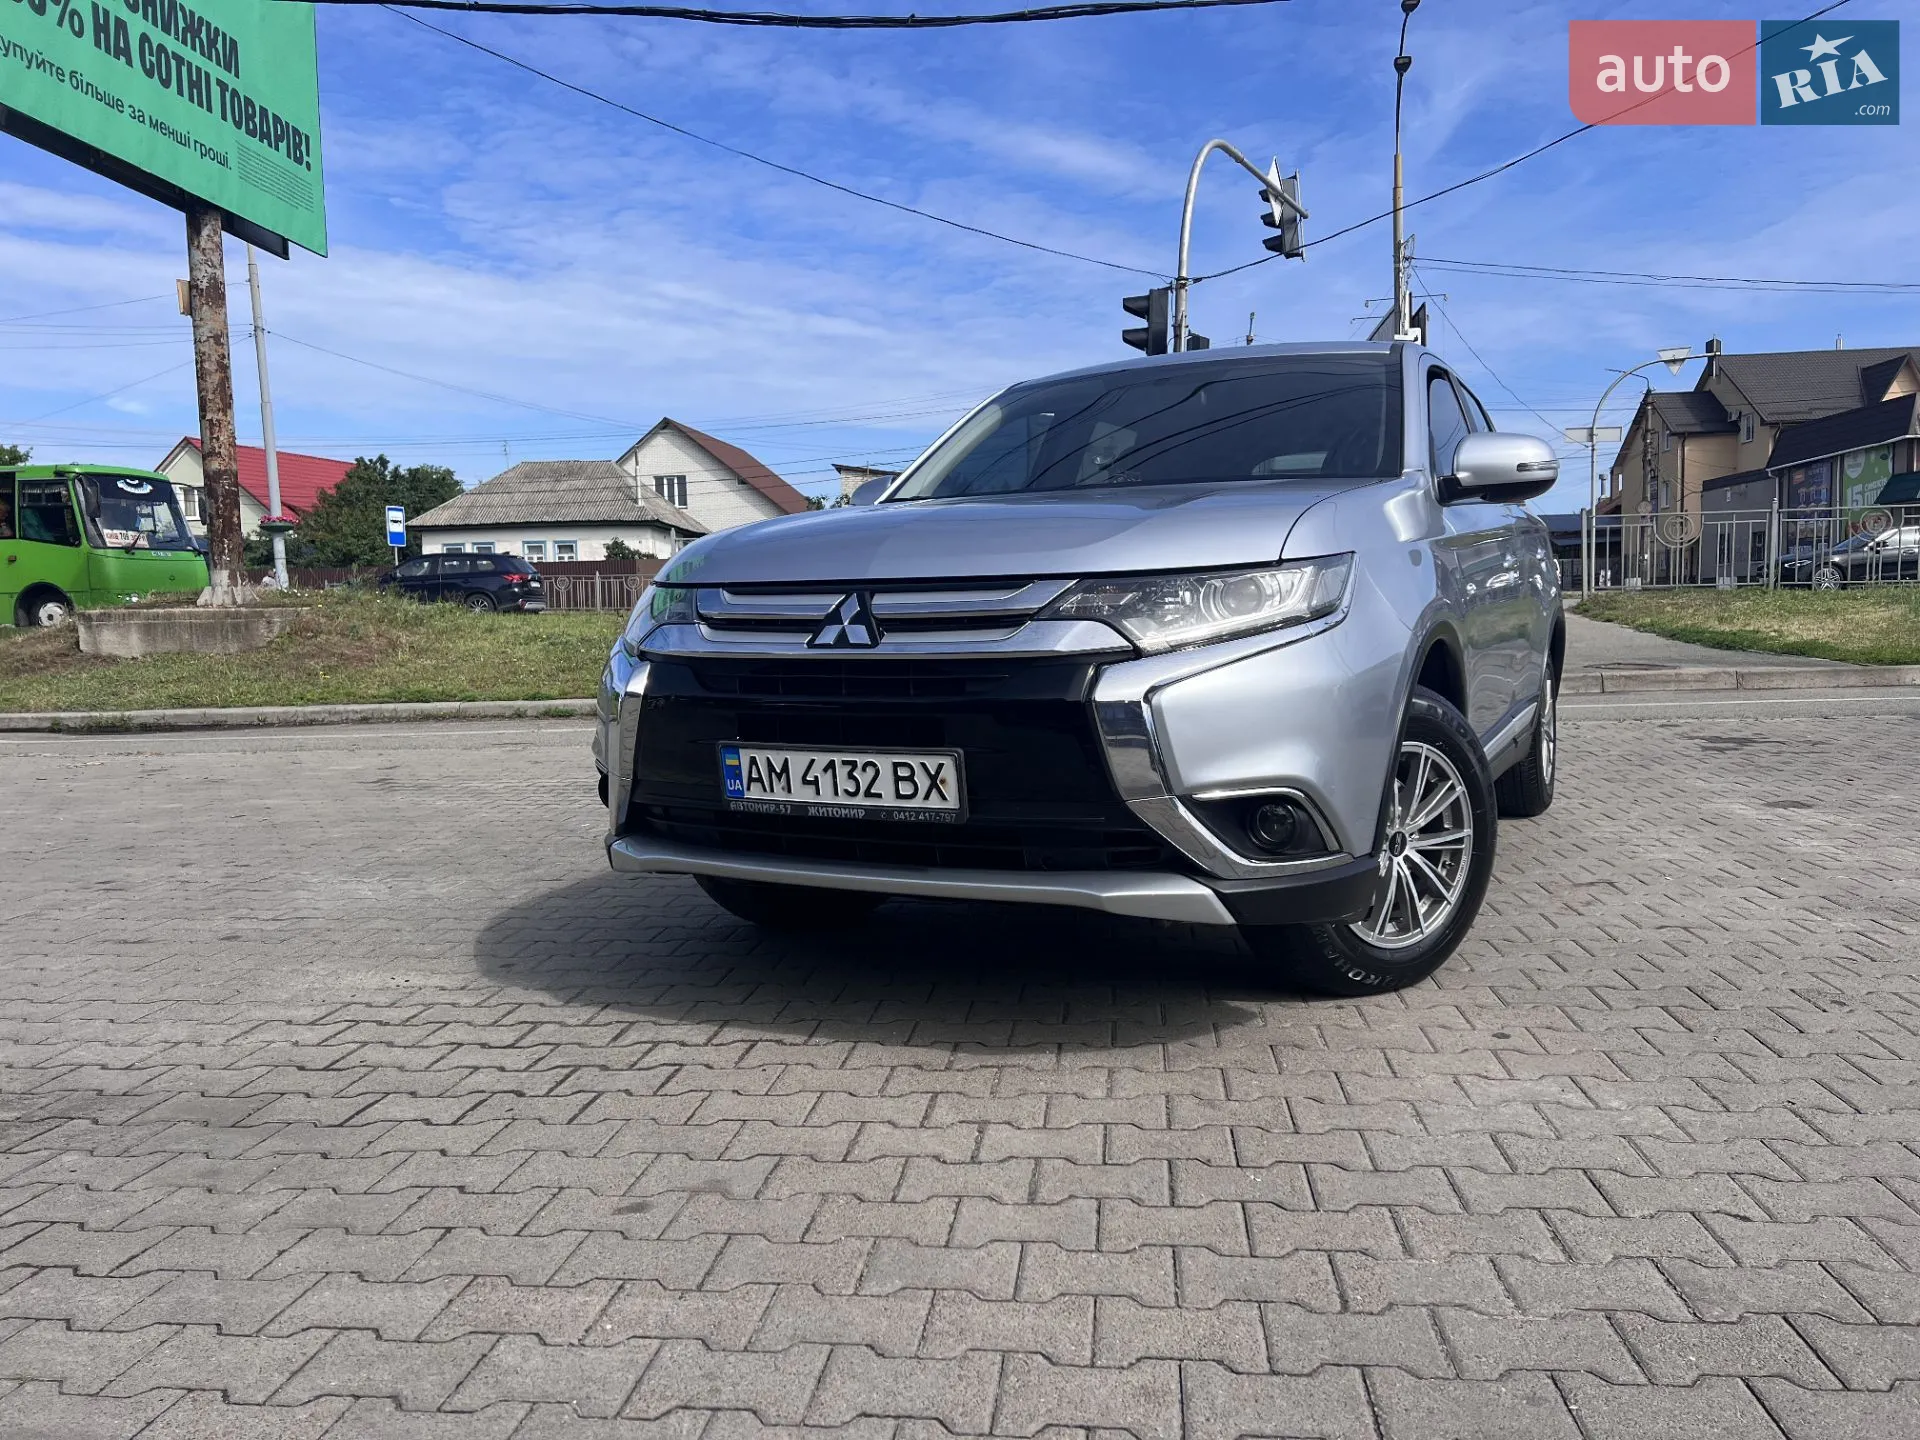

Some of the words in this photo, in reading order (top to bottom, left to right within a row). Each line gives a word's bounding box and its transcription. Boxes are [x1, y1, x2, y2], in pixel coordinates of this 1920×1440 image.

[91, 0, 133, 68] НА
[138, 31, 213, 114] СОТНІ
[216, 77, 311, 172] ТОВАРІВ!
[69, 69, 125, 114] більше
[128, 104, 146, 126] за
[149, 114, 191, 149] менші
[193, 138, 232, 170] гроші.
[727, 779, 743, 791] UA
[747, 755, 793, 794] AM
[801, 758, 883, 799] 4132
[892, 760, 949, 801] BX
[730, 801, 791, 815] АВТОМИР-57
[807, 806, 866, 819] ЖИТОМИР
[893, 811, 916, 821] 0412
[918, 812, 956, 823] 417-797
